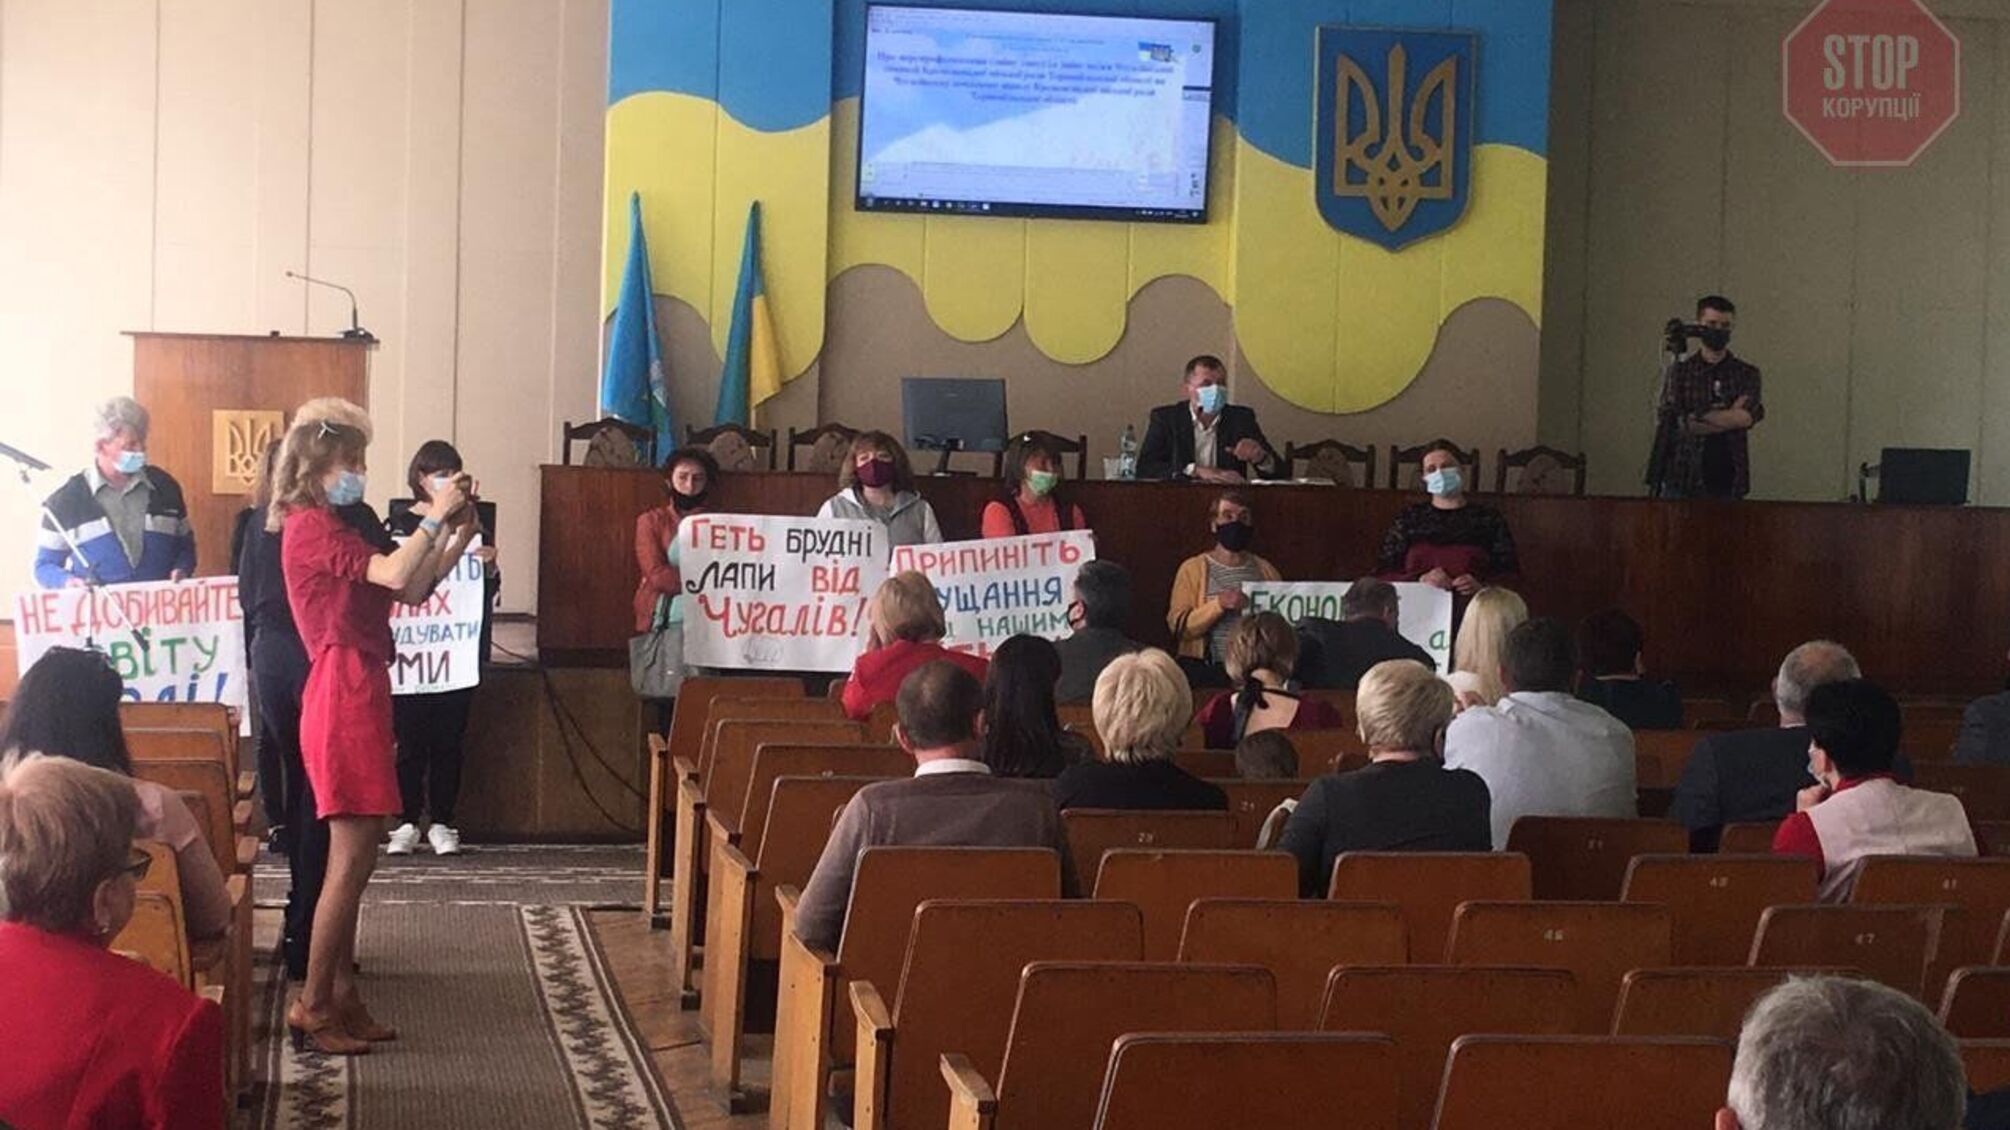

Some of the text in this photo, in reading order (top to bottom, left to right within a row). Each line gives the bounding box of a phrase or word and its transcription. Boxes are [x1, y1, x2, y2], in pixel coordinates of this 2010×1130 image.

[692, 518, 765, 552] ГЕТЬ
[686, 560, 775, 594] ЛАПИ
[936, 577, 1062, 614] УЩАННЯ
[20, 583, 242, 636] НЕ ДОБИВАЙТЕ
[698, 594, 867, 638] Чугалів!
[1250, 590, 1345, 624] ЕКОНО
[95, 627, 219, 680] ВІТУ
